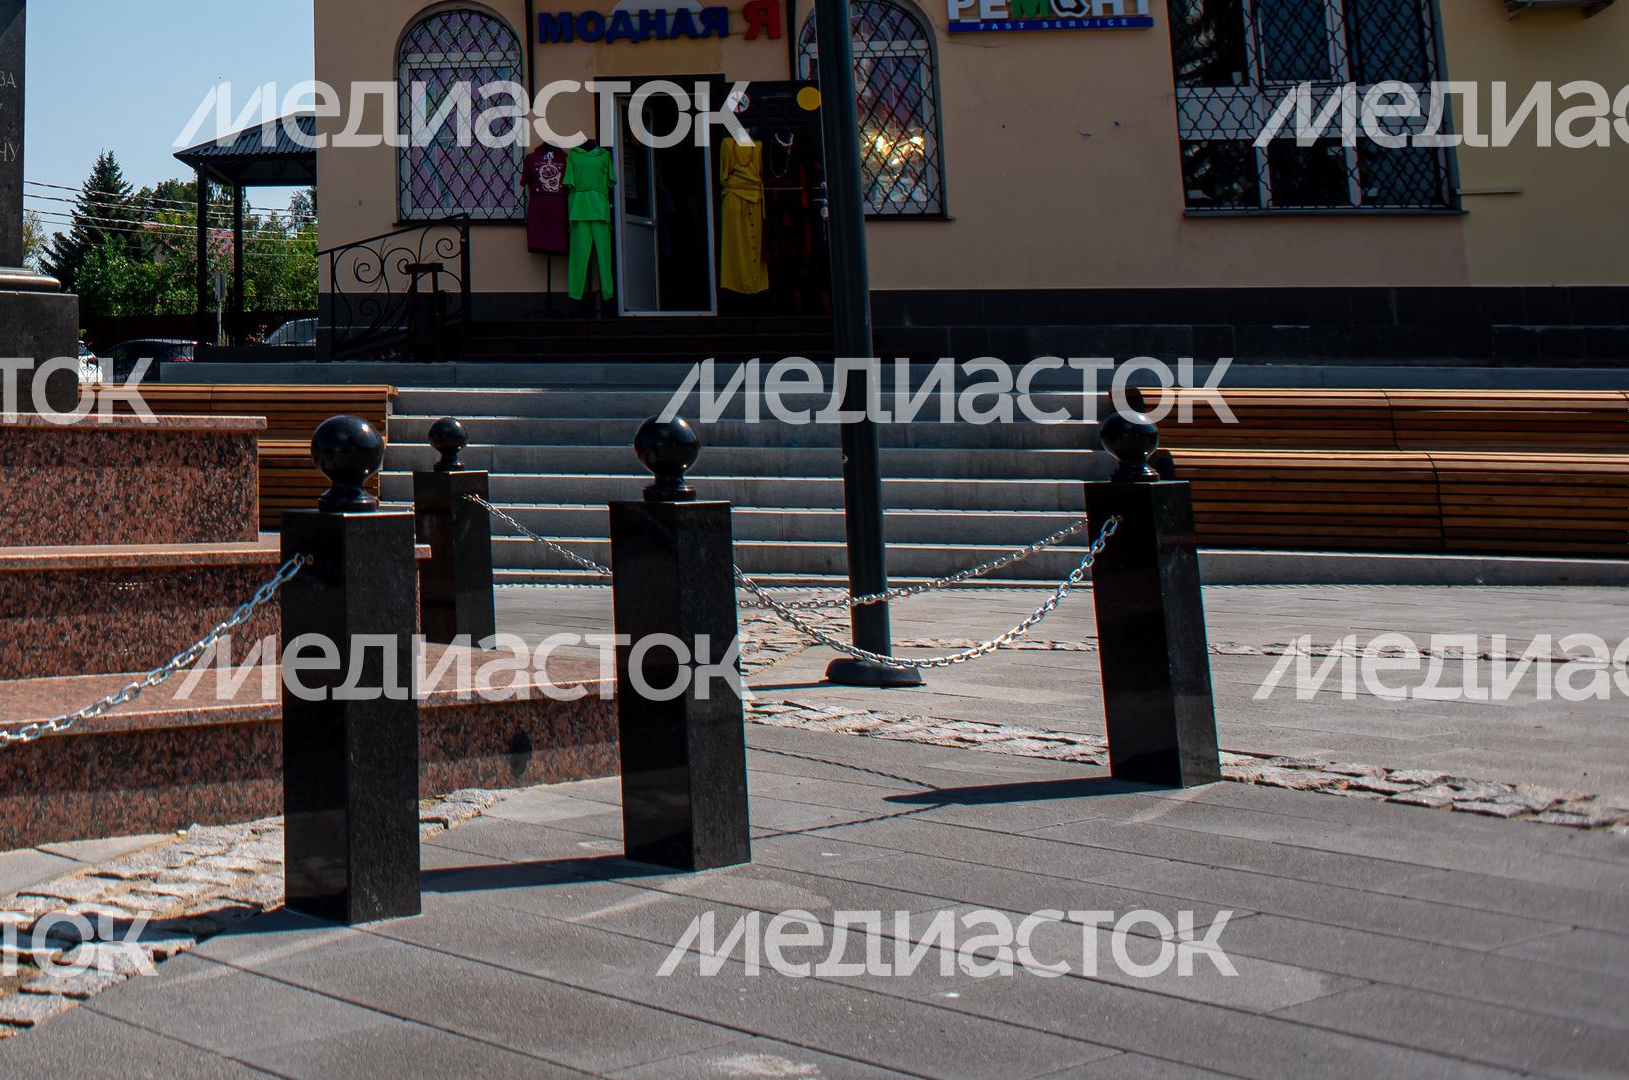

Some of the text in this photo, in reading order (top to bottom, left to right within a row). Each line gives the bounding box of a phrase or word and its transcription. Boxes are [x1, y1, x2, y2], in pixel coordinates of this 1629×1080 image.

[538, 0, 782, 45] МОДНАЯ Я
[979, 18, 1129, 31] FAST SERVICE
